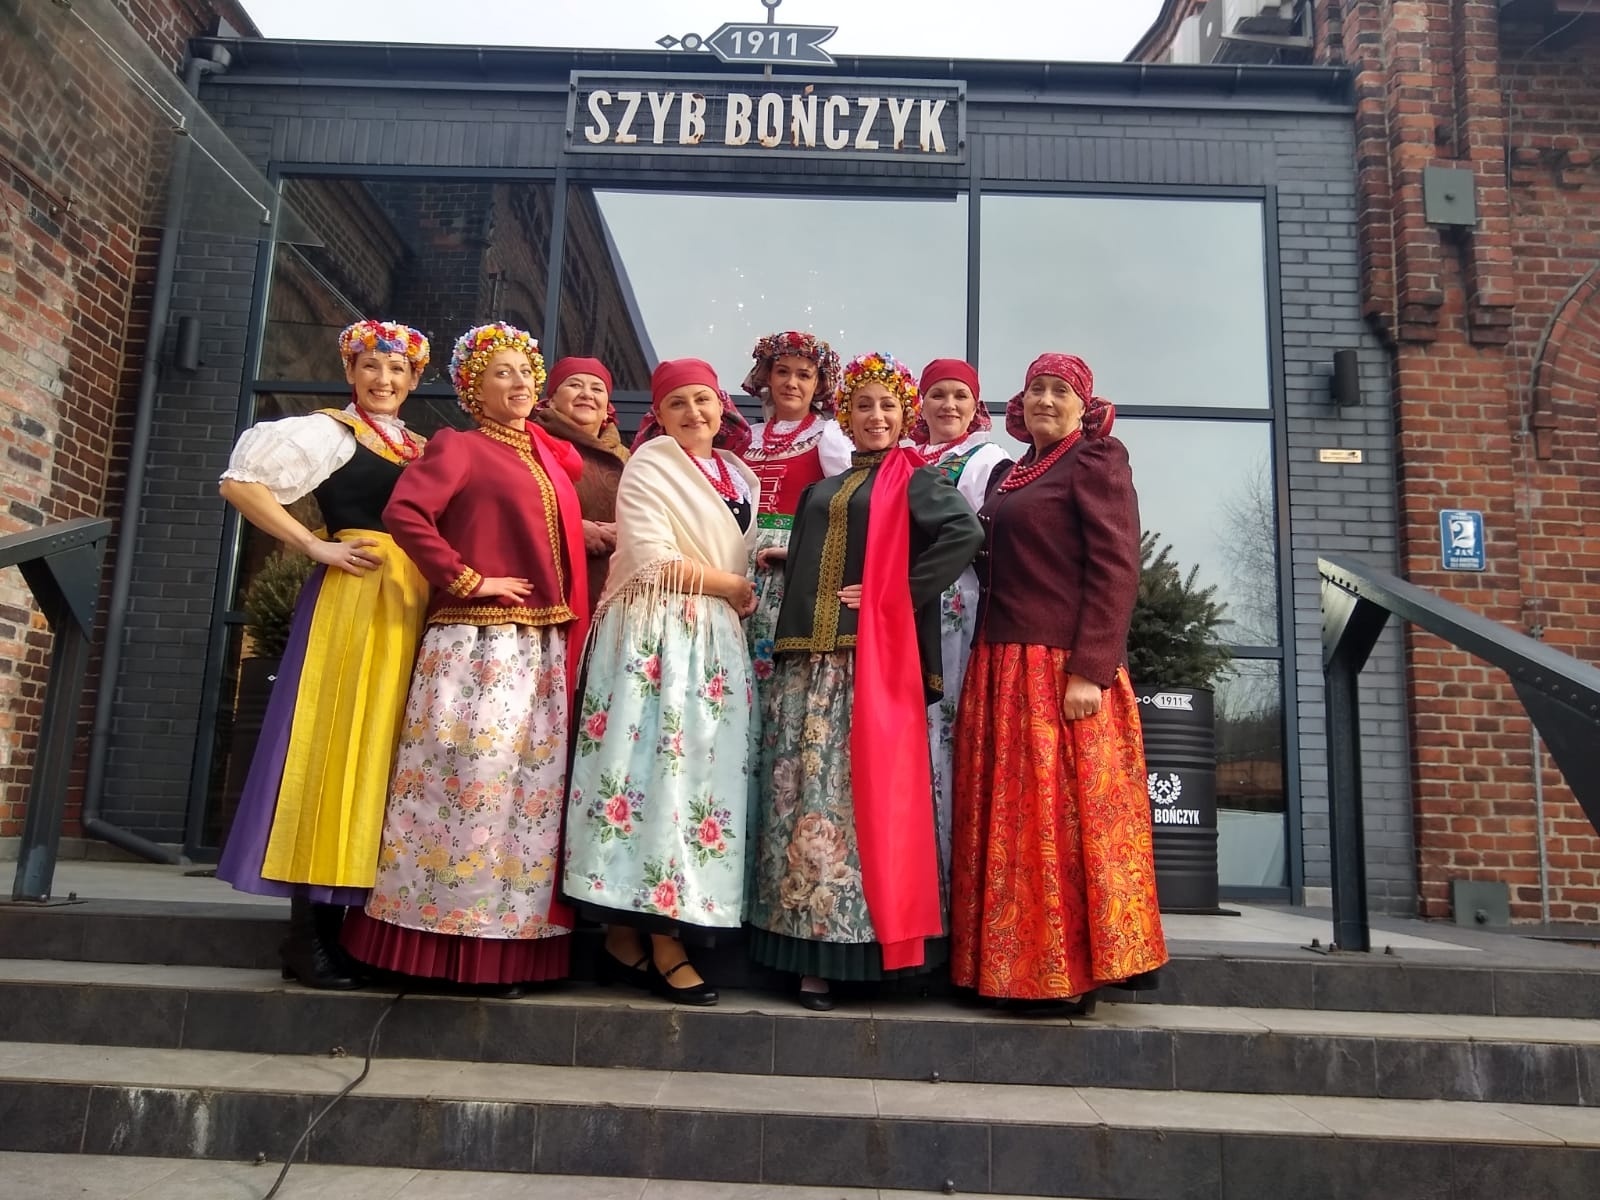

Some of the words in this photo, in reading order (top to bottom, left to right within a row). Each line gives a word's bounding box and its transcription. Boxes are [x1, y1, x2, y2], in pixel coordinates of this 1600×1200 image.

[730, 31, 798, 56] 1911
[584, 90, 707, 146] SZYB
[724, 84, 947, 153] BOŃCZYK
[1161, 696, 1182, 706] 1911
[1154, 805, 1200, 825] BOŃCZYK
